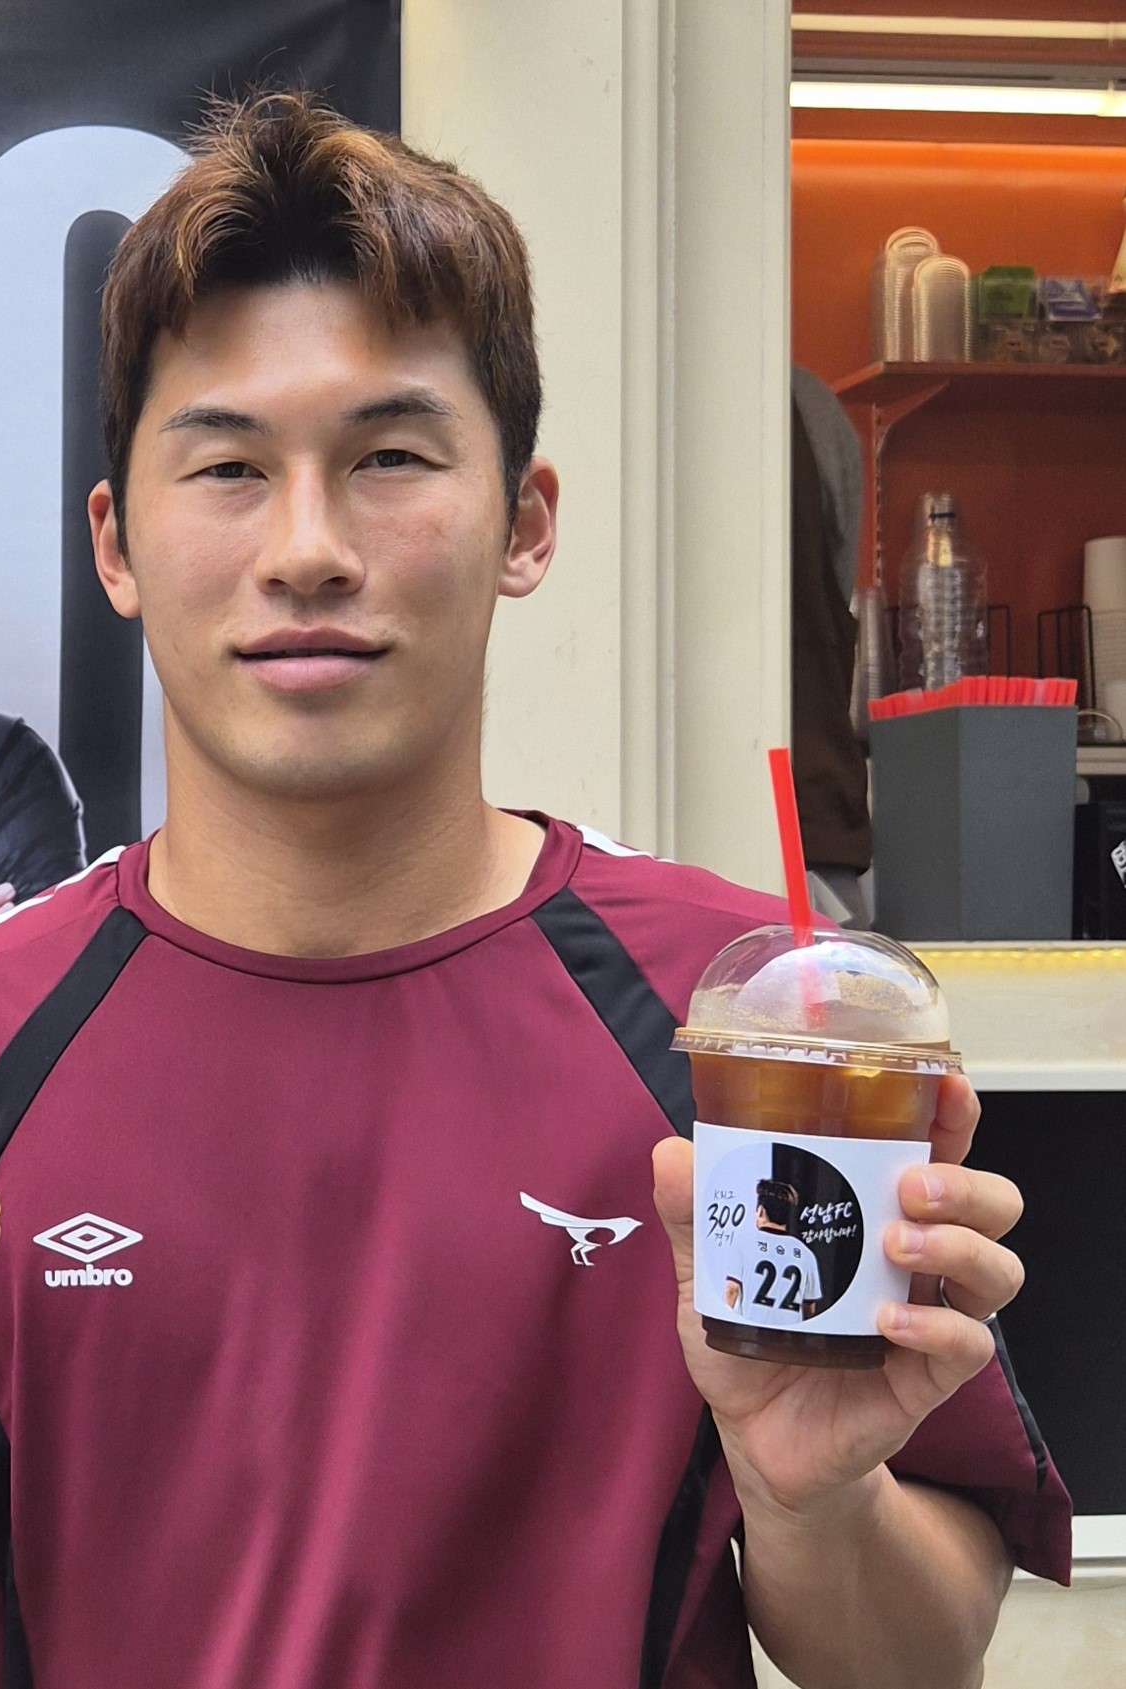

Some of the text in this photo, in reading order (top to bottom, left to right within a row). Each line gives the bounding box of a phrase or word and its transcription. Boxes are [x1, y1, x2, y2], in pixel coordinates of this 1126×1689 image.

[706, 1202, 746, 1238] 300
[800, 1201, 853, 1224] 성남FC
[715, 1230, 734, 1247] 경기
[801, 1225, 857, 1244] 감사합니다!
[44, 1263, 133, 1287] umbro
[752, 1260, 802, 1312] 22
